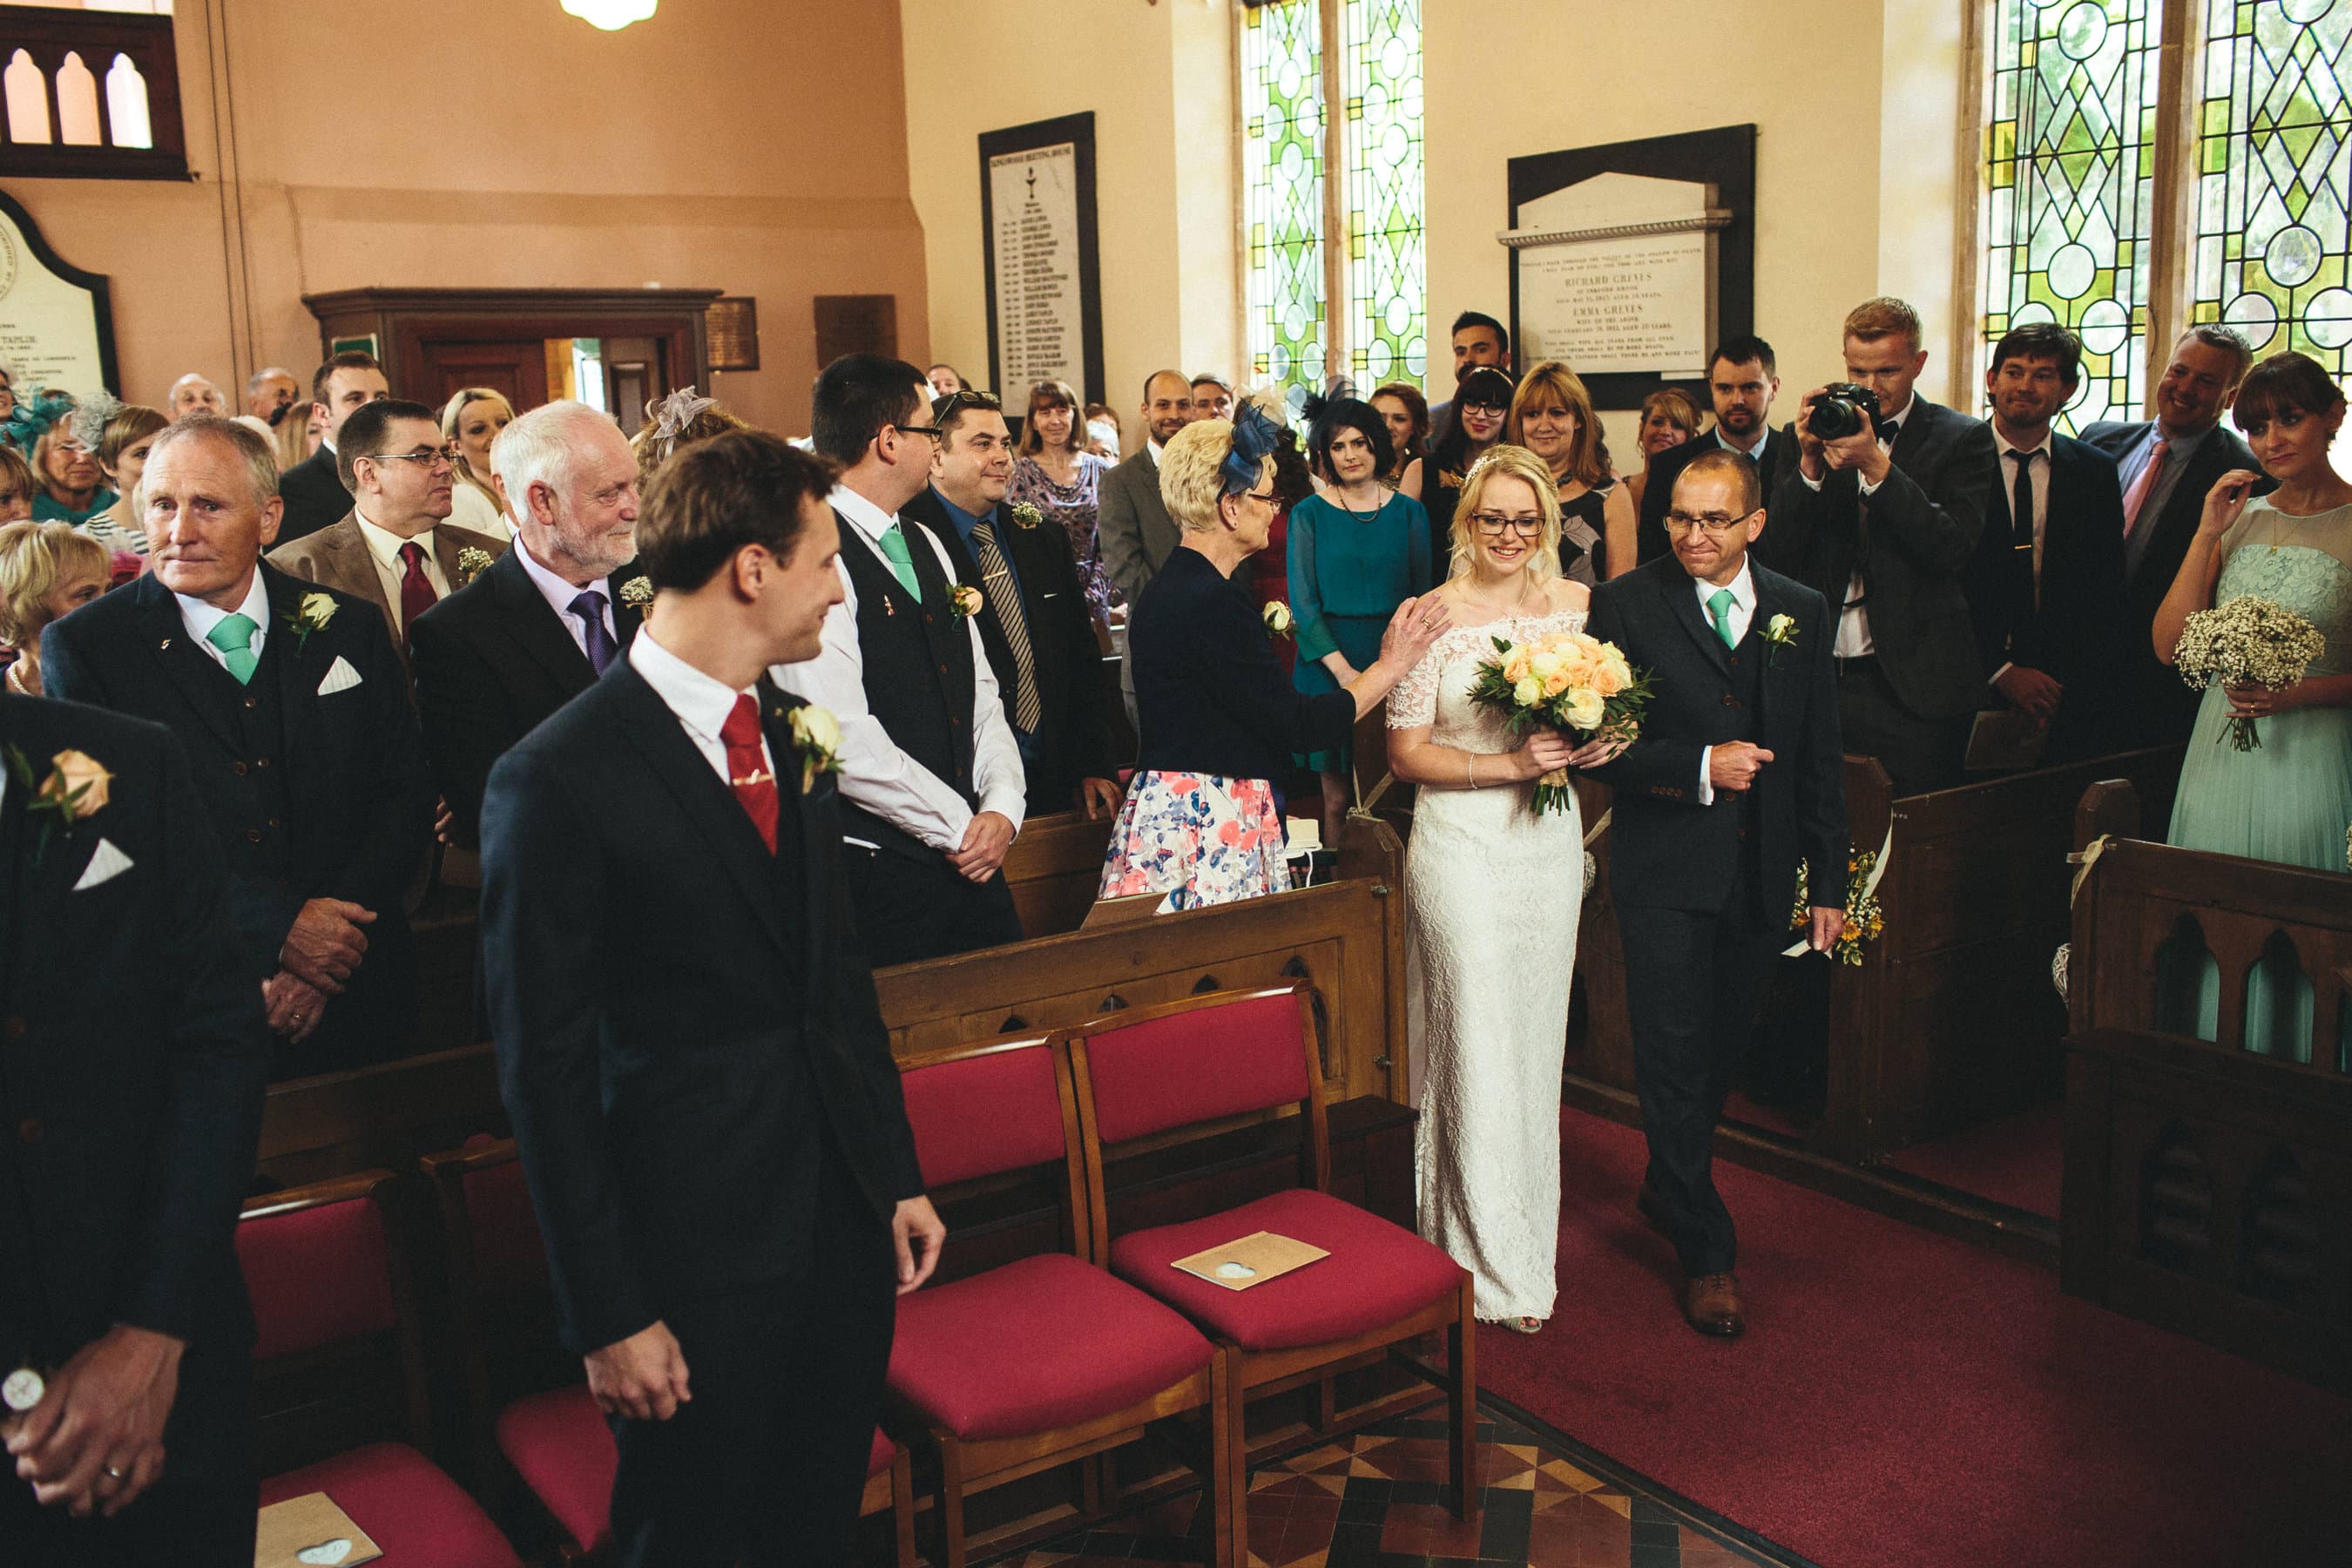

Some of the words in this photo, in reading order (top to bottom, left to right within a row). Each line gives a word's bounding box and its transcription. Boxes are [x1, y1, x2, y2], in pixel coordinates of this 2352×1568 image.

[1565, 275, 1609, 287] RICHARD
[1612, 273, 1652, 283] GREVES
[1573, 306, 1600, 316] EMMA
[1604, 304, 1643, 314] GREVES
